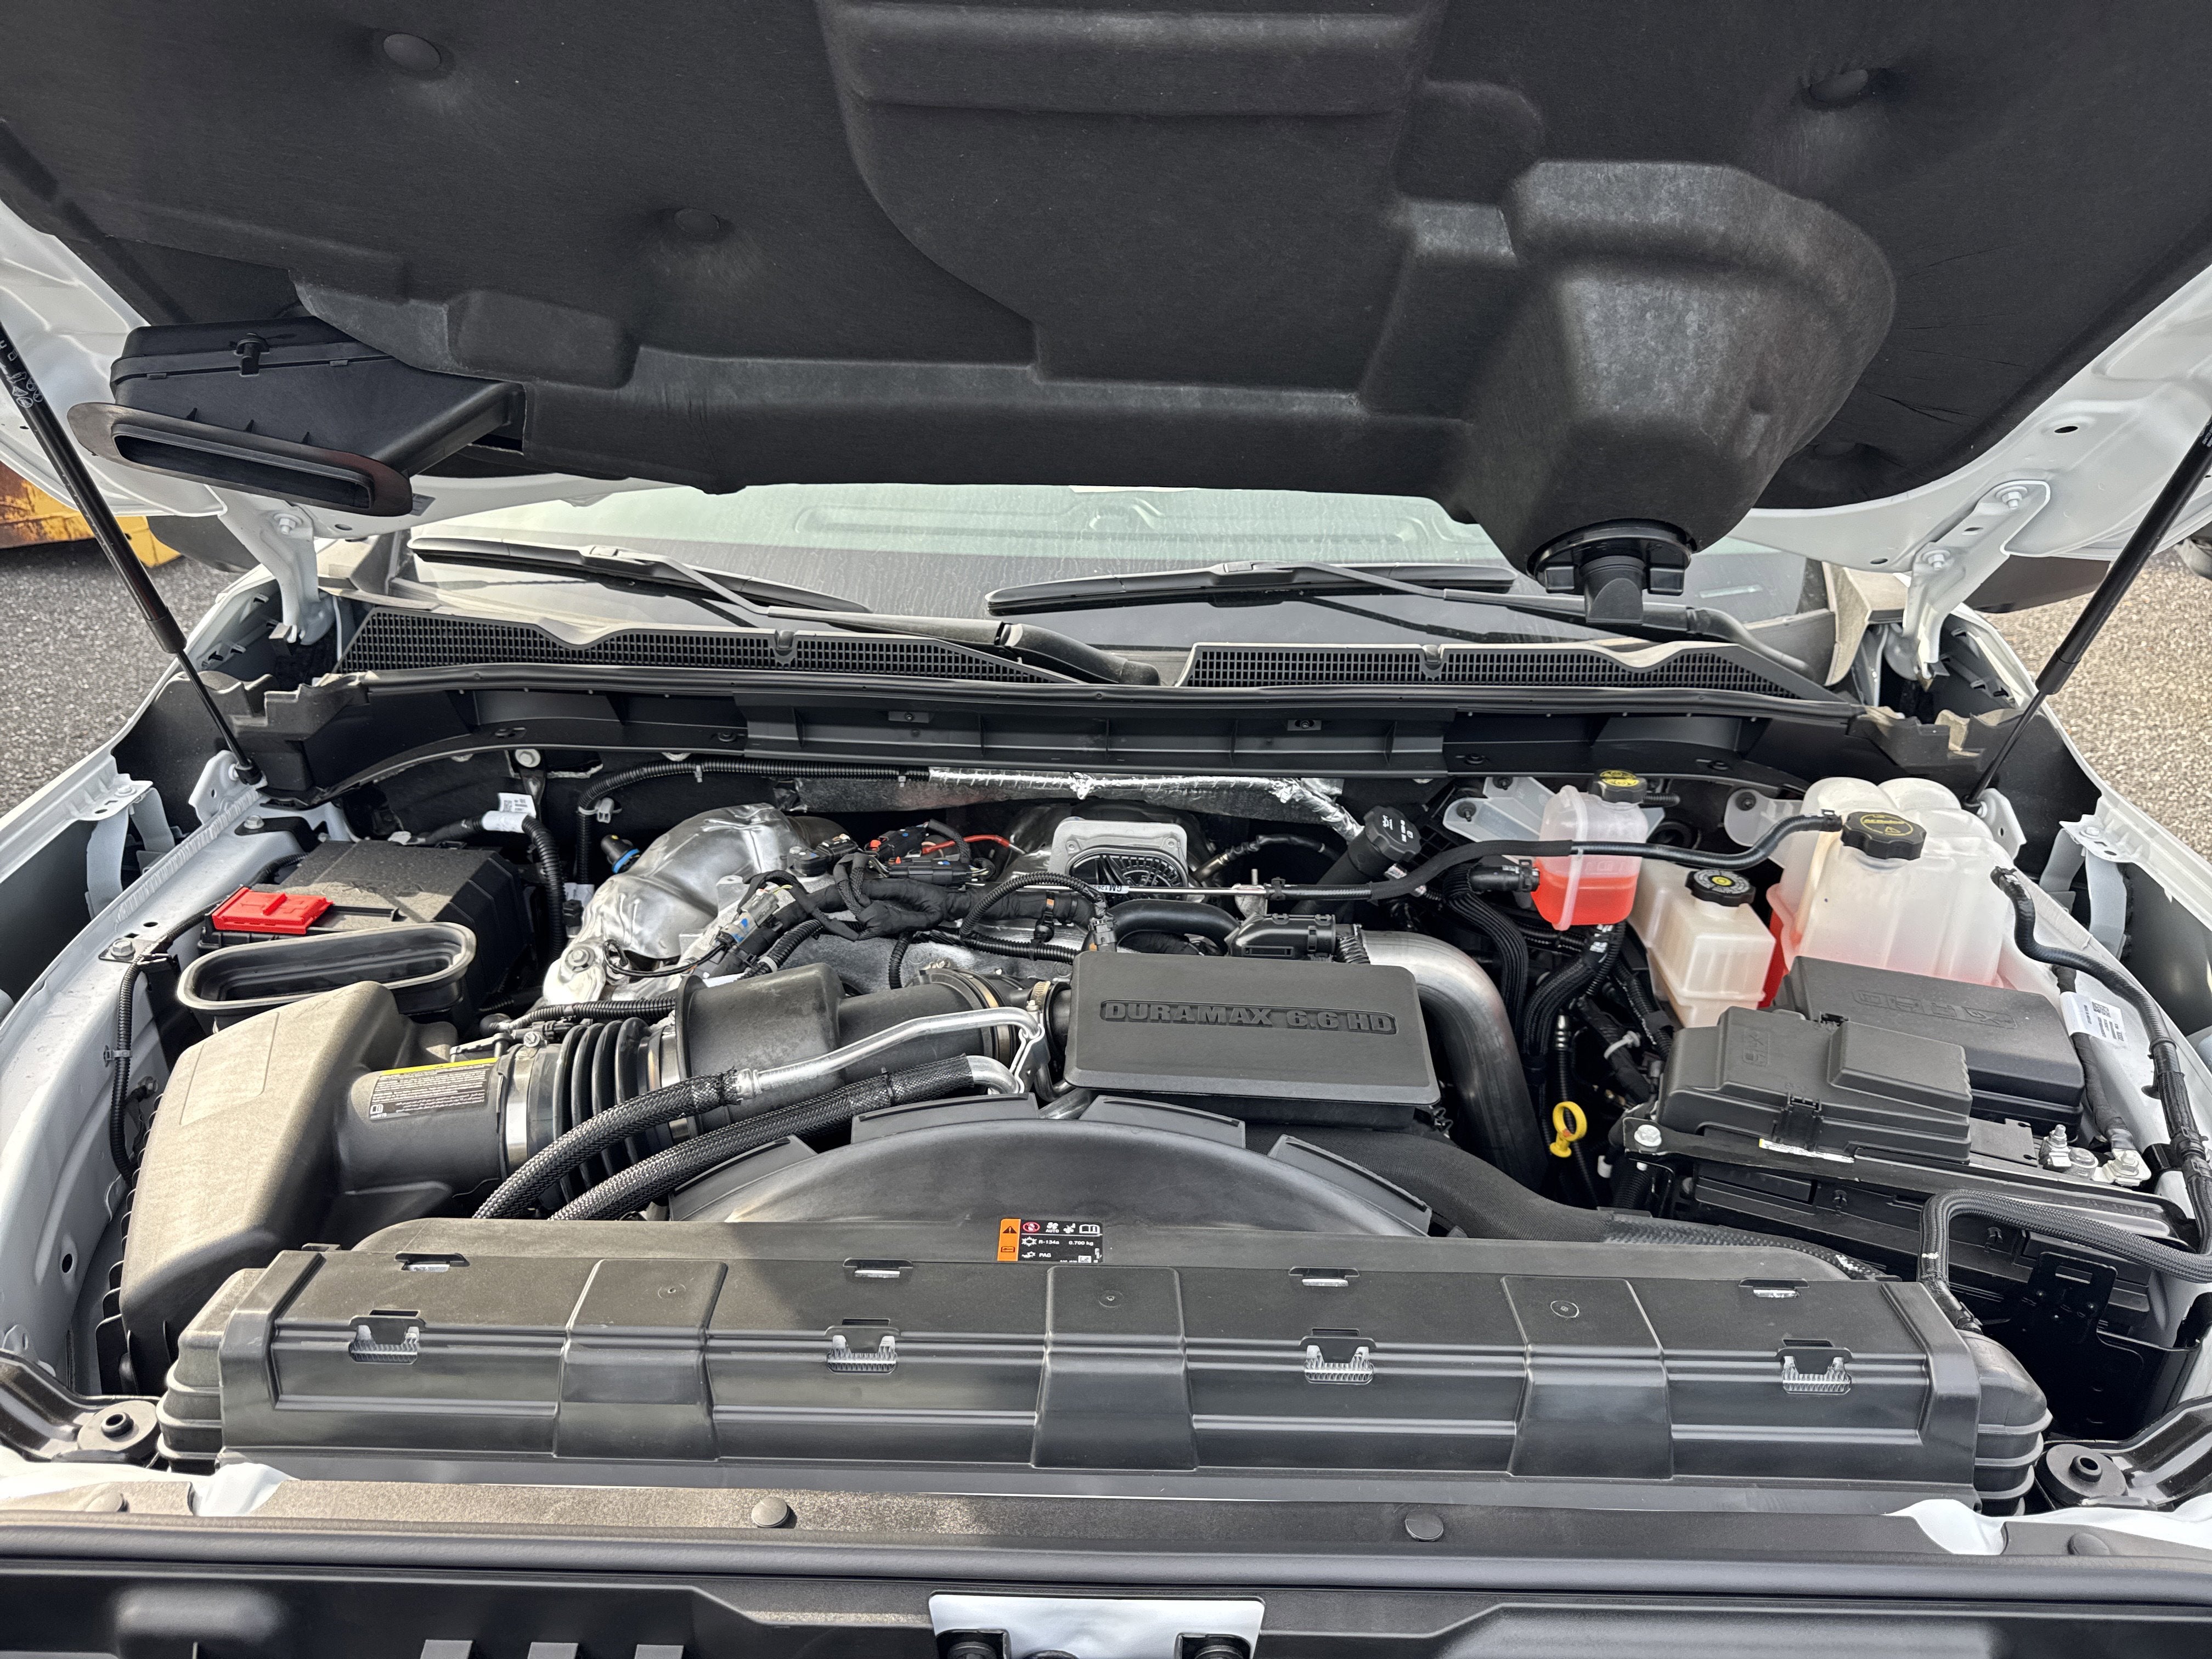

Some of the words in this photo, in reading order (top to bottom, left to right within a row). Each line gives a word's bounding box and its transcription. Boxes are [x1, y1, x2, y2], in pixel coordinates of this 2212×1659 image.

[1105, 1002, 1273, 1026] DURAMAX
[1286, 1009, 1339, 1029] 6.6
[1346, 1012, 1392, 1032] HD
